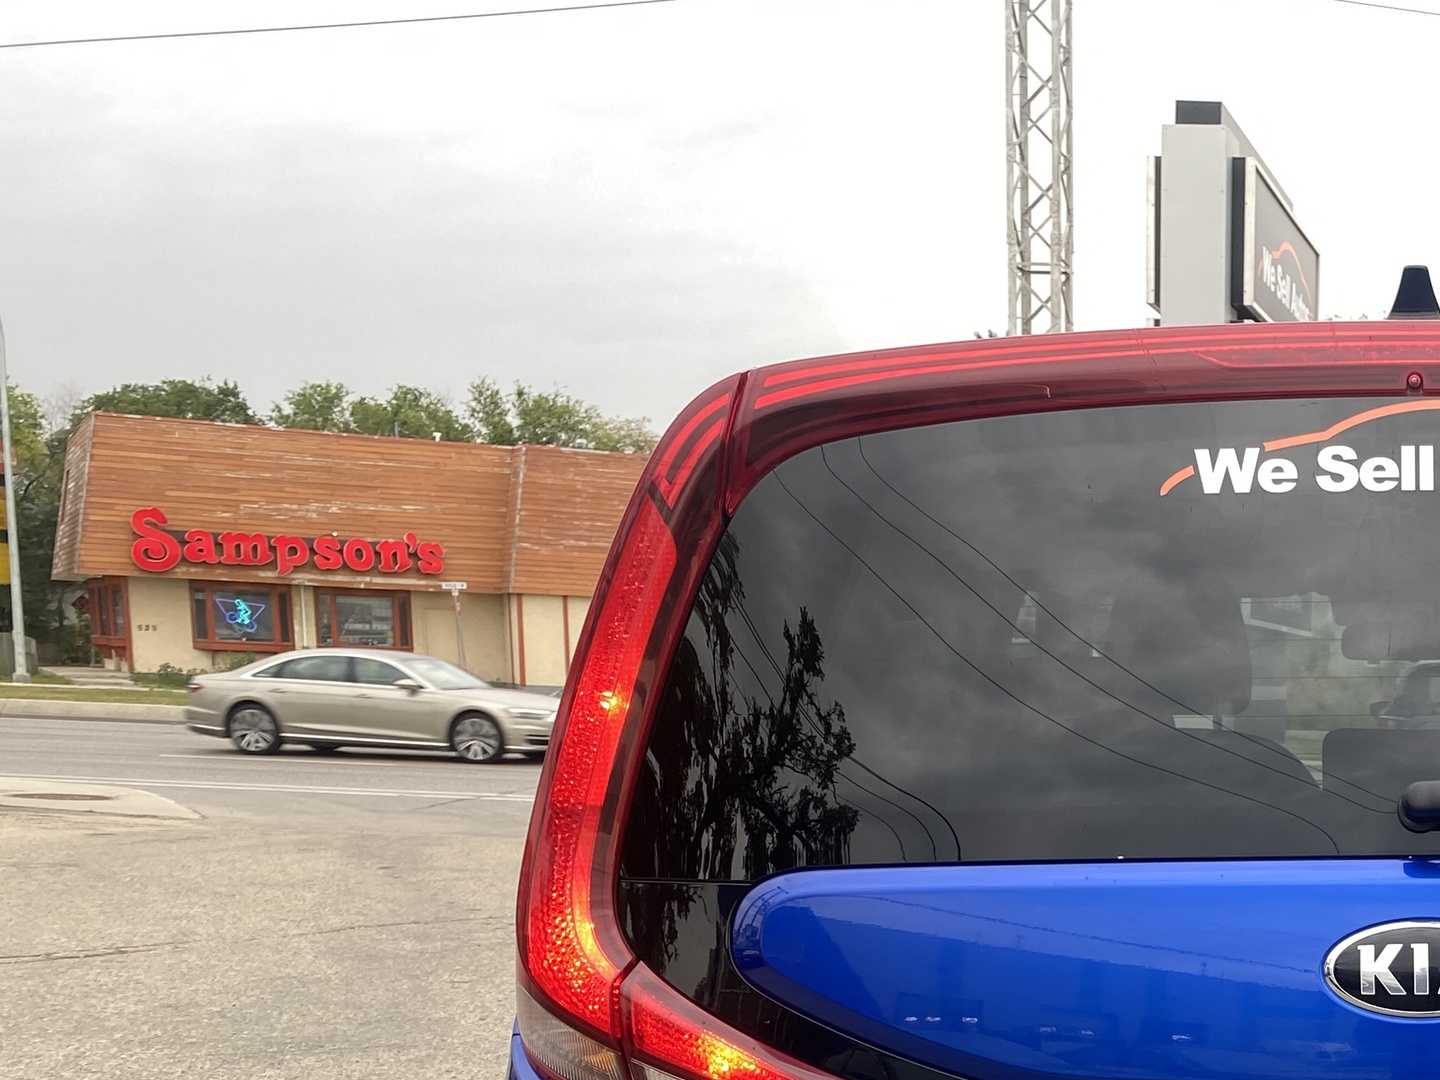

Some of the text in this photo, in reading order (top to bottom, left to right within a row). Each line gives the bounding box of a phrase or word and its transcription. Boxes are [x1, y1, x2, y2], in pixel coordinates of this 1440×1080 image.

[1262, 245, 1276, 293] We
[1276, 263, 1291, 310] Sell
[1194, 447, 1298, 495] We
[1315, 445, 1434, 492] Sell
[130, 506, 445, 576] Sampson's
